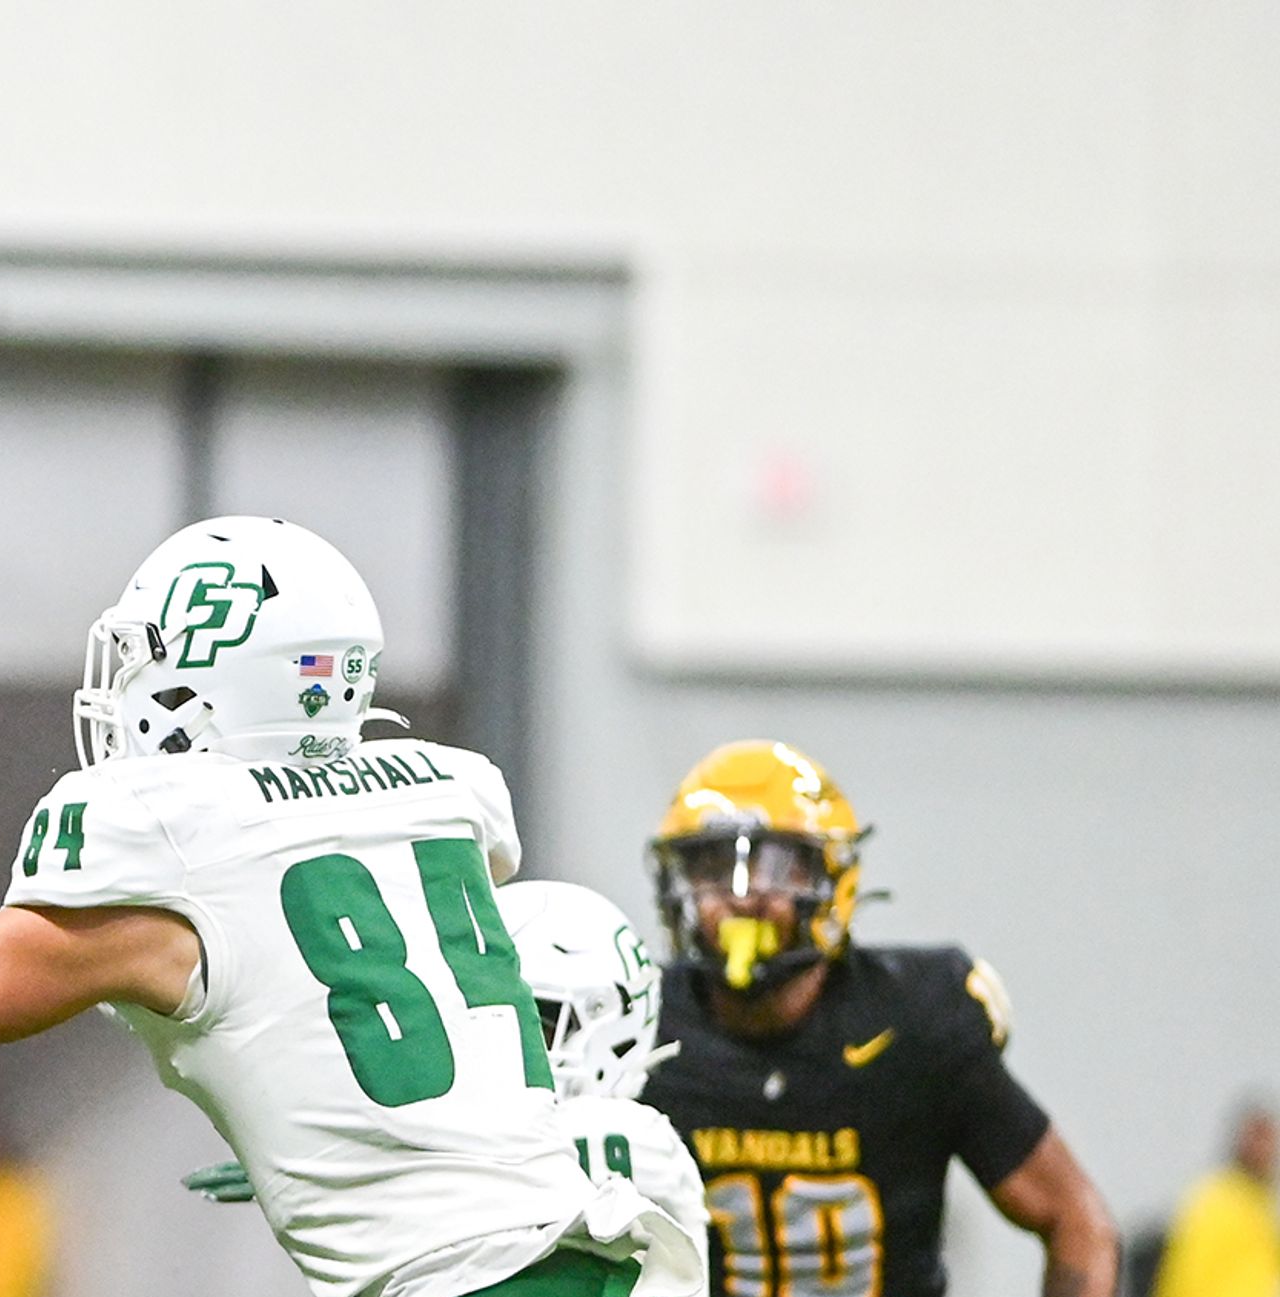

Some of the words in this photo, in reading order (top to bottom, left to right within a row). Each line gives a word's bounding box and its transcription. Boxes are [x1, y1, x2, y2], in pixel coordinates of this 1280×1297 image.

[248, 750, 455, 803] MARSHALL
[22, 801, 88, 878] 84
[280, 838, 556, 1108] 84
